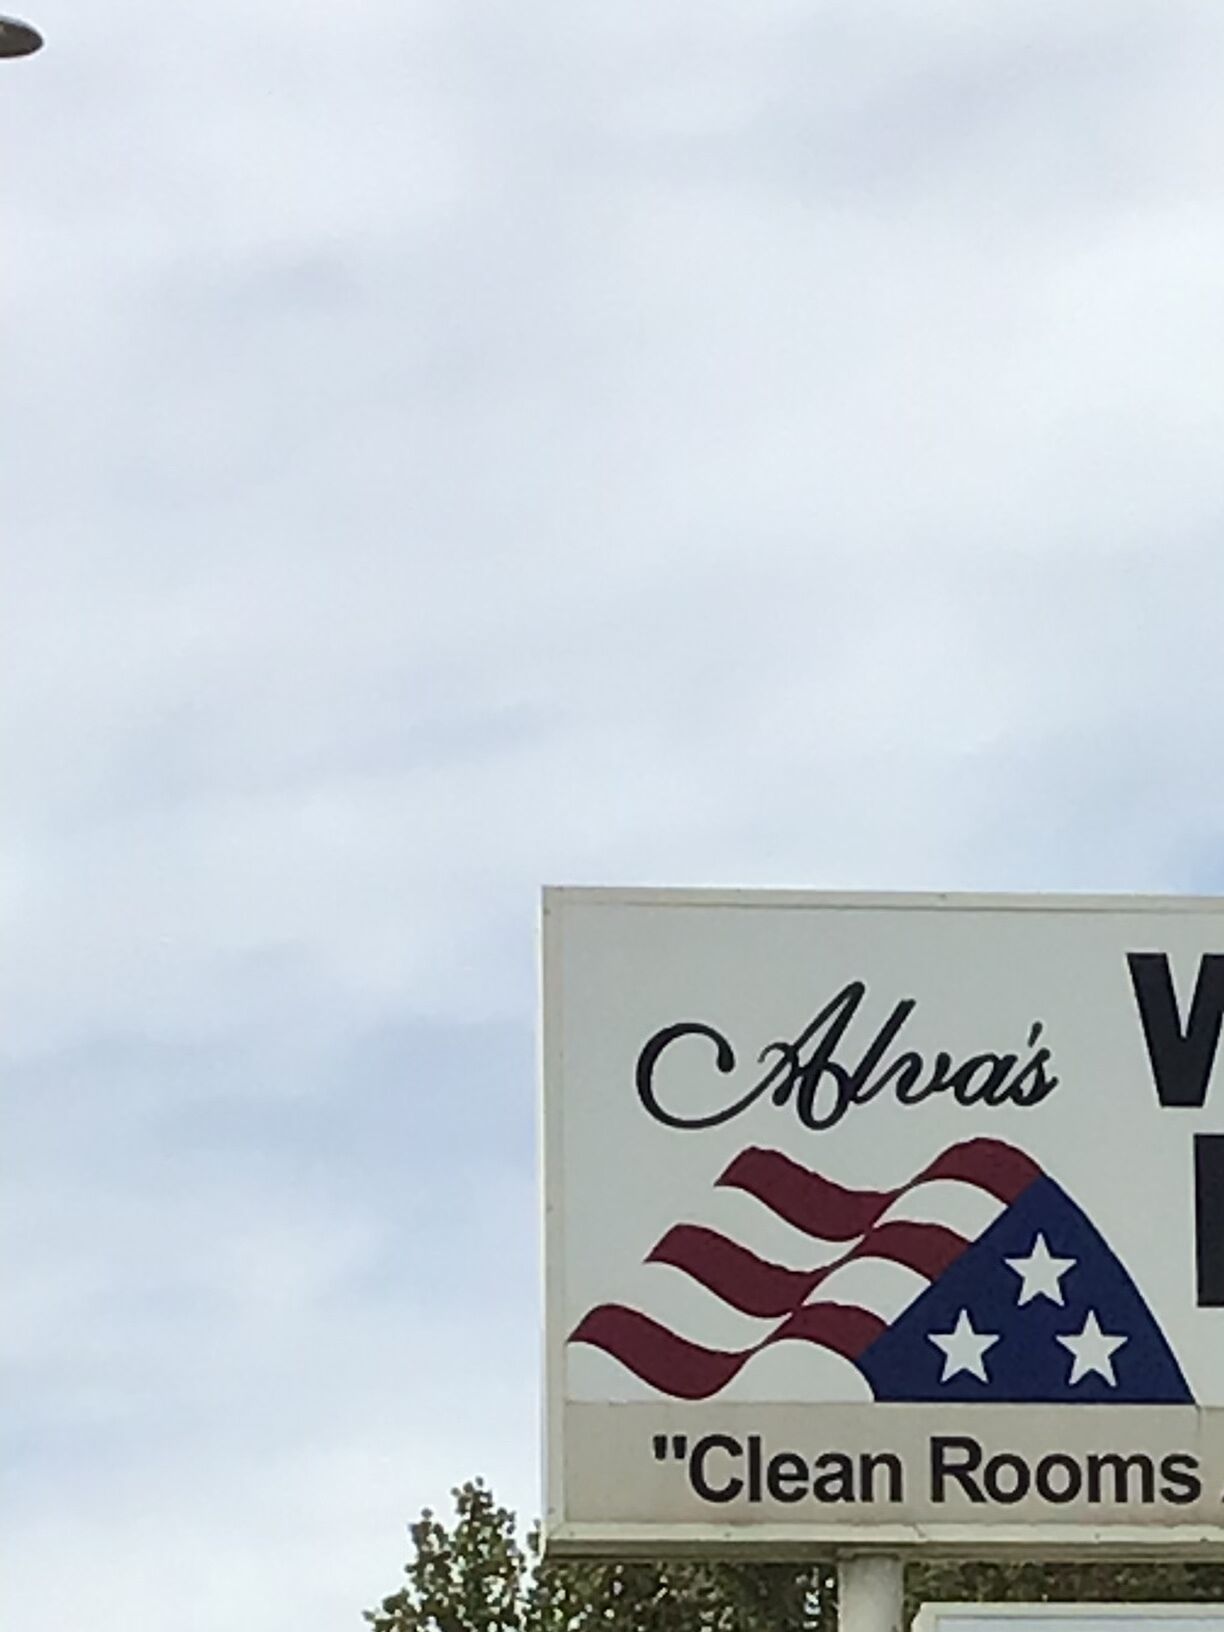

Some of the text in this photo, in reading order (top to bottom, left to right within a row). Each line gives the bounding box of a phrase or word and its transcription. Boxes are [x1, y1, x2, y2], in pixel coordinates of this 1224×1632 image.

[636, 981, 1058, 1130] Alva's
[653, 1433, 902, 1504] "Clean
[930, 1436, 1201, 1504] Rooms
